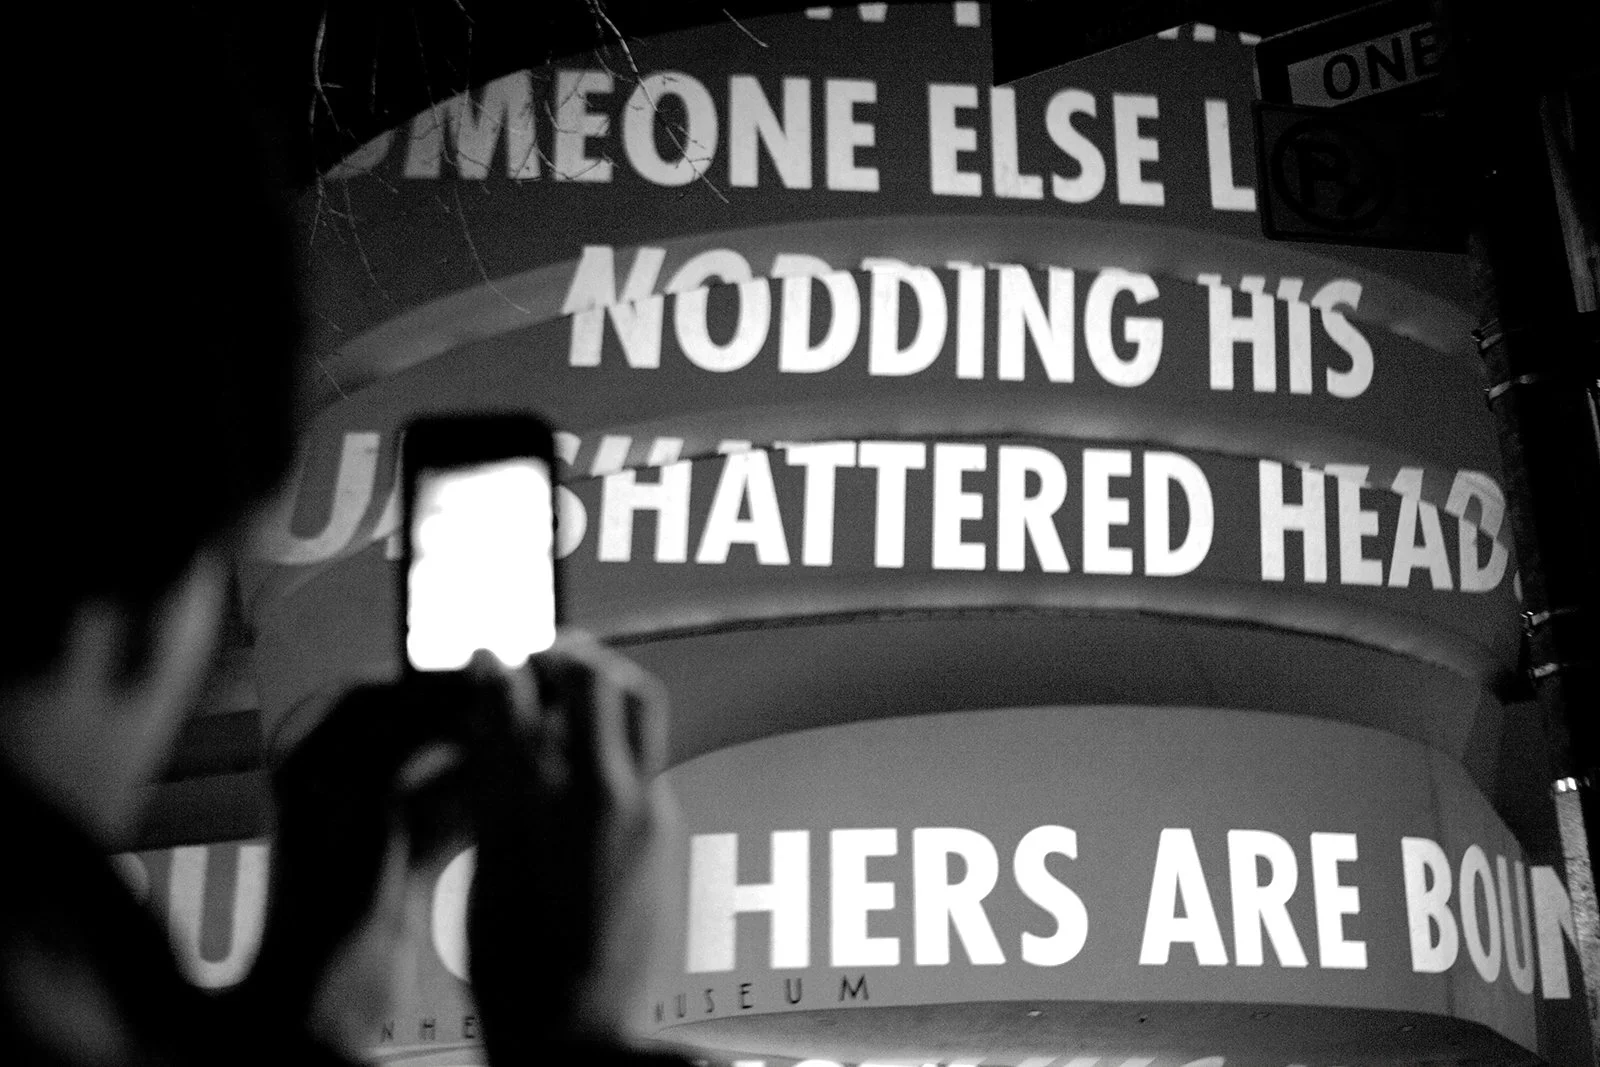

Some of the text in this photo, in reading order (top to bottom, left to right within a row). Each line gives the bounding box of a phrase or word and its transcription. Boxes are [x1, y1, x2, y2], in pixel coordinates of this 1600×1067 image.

[1323, 30, 1440, 101] ONE
[928, 83, 1165, 207] ELSE
[562, 245, 1375, 399] NODDING HIS
[254, 431, 1214, 578] UHATTERED
[1138, 827, 1368, 970] ARE
